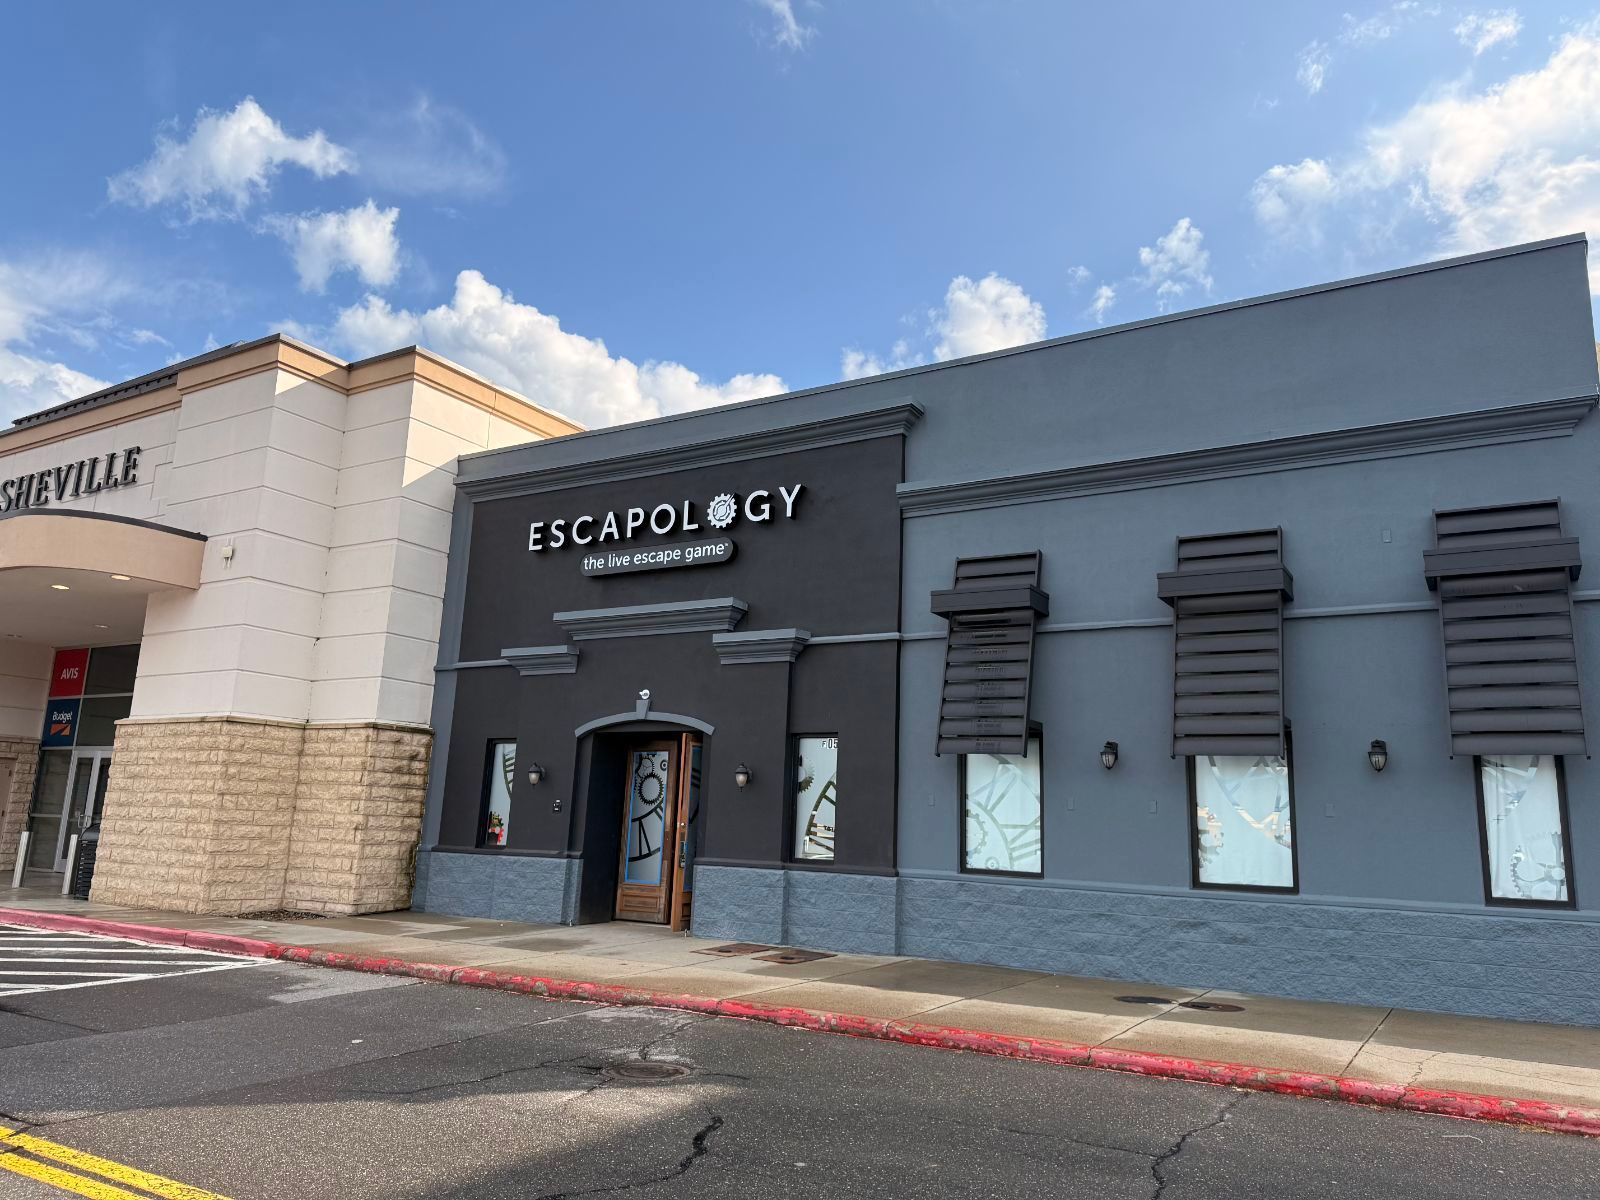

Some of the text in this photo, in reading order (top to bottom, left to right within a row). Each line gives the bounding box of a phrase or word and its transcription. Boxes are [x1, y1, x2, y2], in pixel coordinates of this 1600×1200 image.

[0, 446, 141, 512] SHEVILLE
[528, 483, 802, 551] ESCAPOLOGY
[584, 556, 604, 570] the
[608, 554, 630, 568] live
[633, 549, 681, 564] escape
[60, 667, 79, 680] AVIS
[52, 711, 73, 724] Budget
